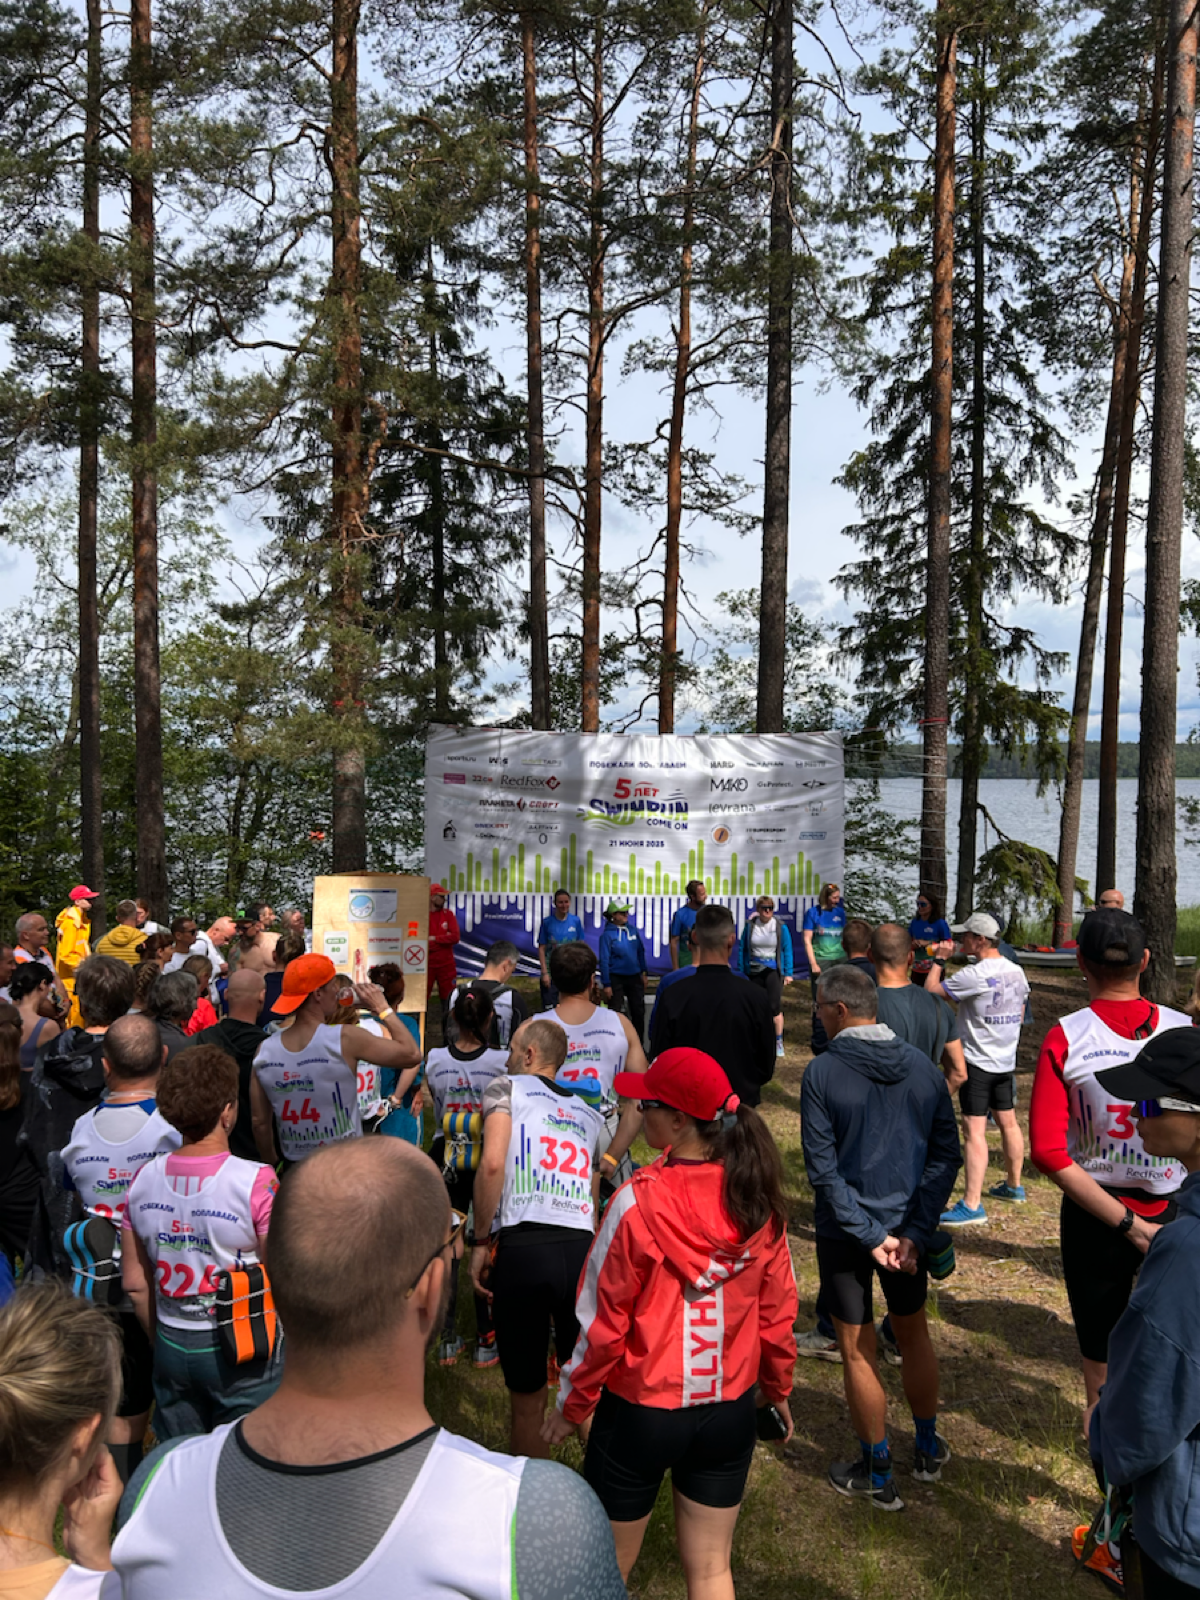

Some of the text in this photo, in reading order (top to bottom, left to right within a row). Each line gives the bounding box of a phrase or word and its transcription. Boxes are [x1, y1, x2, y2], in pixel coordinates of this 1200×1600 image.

[500, 775, 545, 787] RedFox
[614, 777, 660, 799] 5 ЛЕТ
[479, 799, 515, 808] ПЛАНЕТА
[528, 800, 561, 809] СПОРТ
[646, 818, 689, 830] COME ON
[283, 1071, 290, 1080] 5
[280, 1098, 321, 1125] 44
[108, 1167, 117, 1180] 5
[171, 1220, 181, 1233] 5
